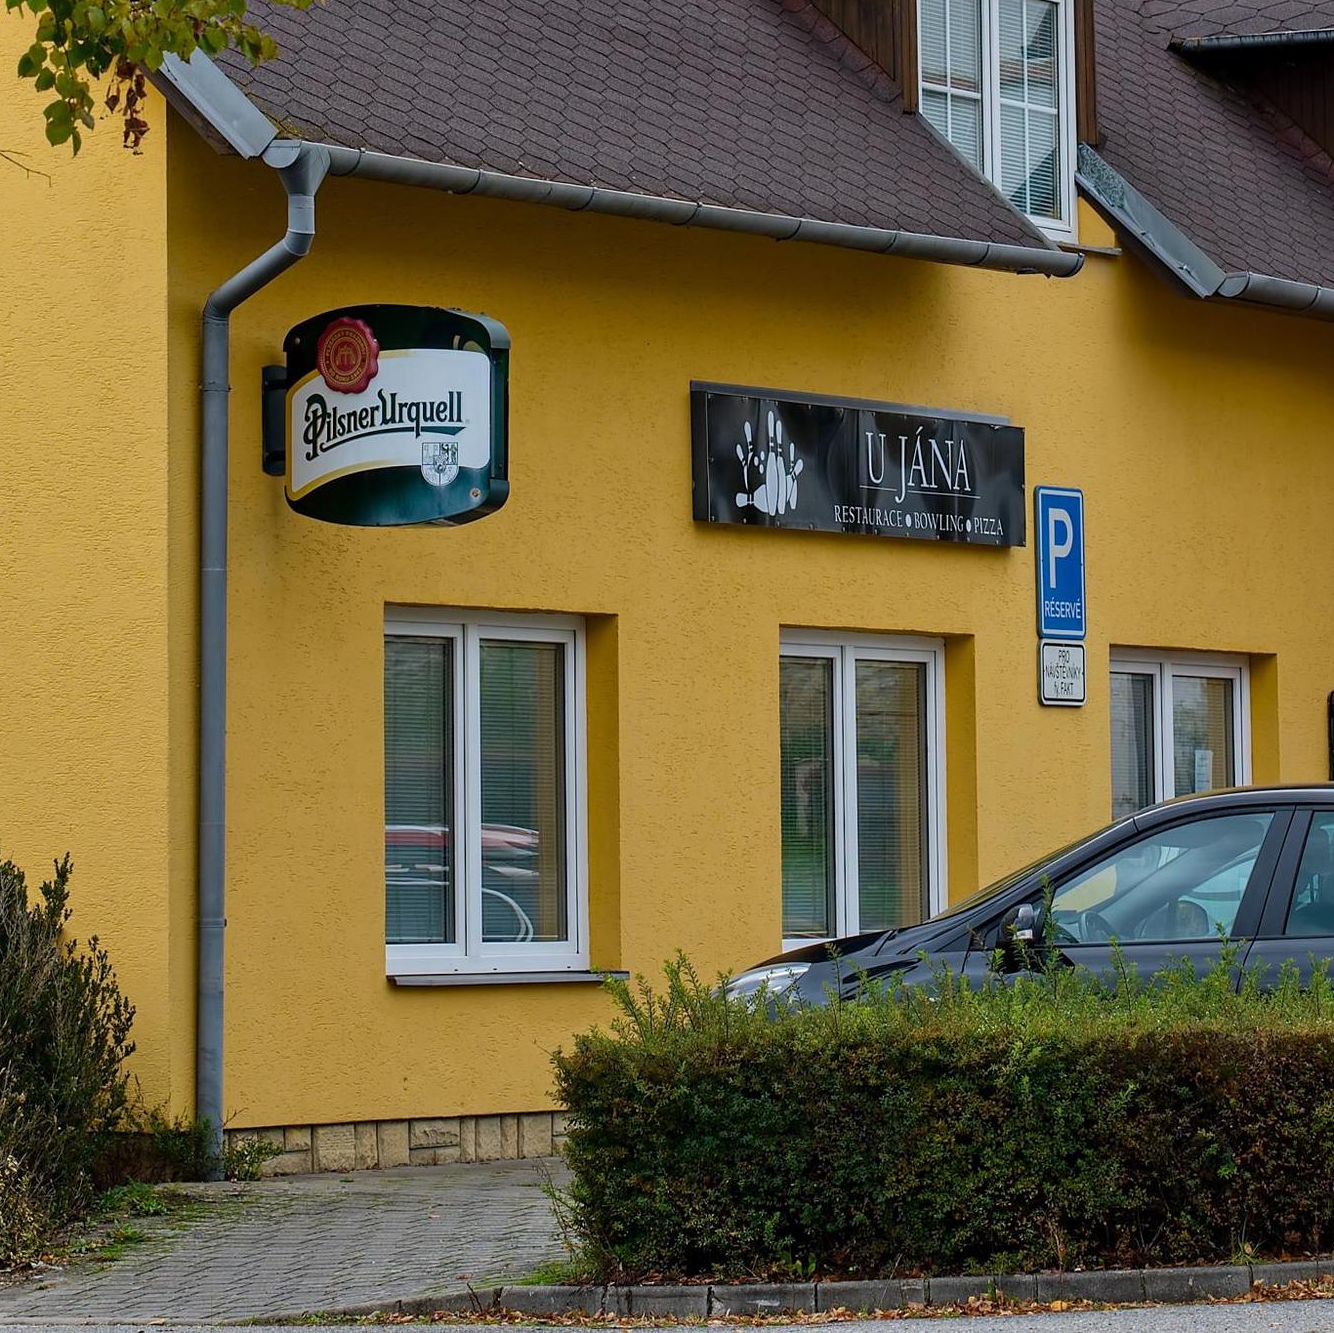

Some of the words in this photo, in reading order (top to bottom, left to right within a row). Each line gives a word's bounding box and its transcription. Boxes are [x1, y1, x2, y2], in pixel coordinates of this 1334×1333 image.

[303, 393, 380, 462] Pilsner
[378, 388, 462, 439] Urquell
[865, 432, 887, 485] U
[895, 426, 972, 504] JÁNA
[834, 504, 903, 529] RESTAURACE
[914, 511, 965, 533] BOWLING
[974, 517, 1005, 537] PIZZA
[1048, 507, 1074, 589] P
[1044, 596, 1082, 619] RÉSERVÉ
[1058, 649, 1071, 664] PRO
